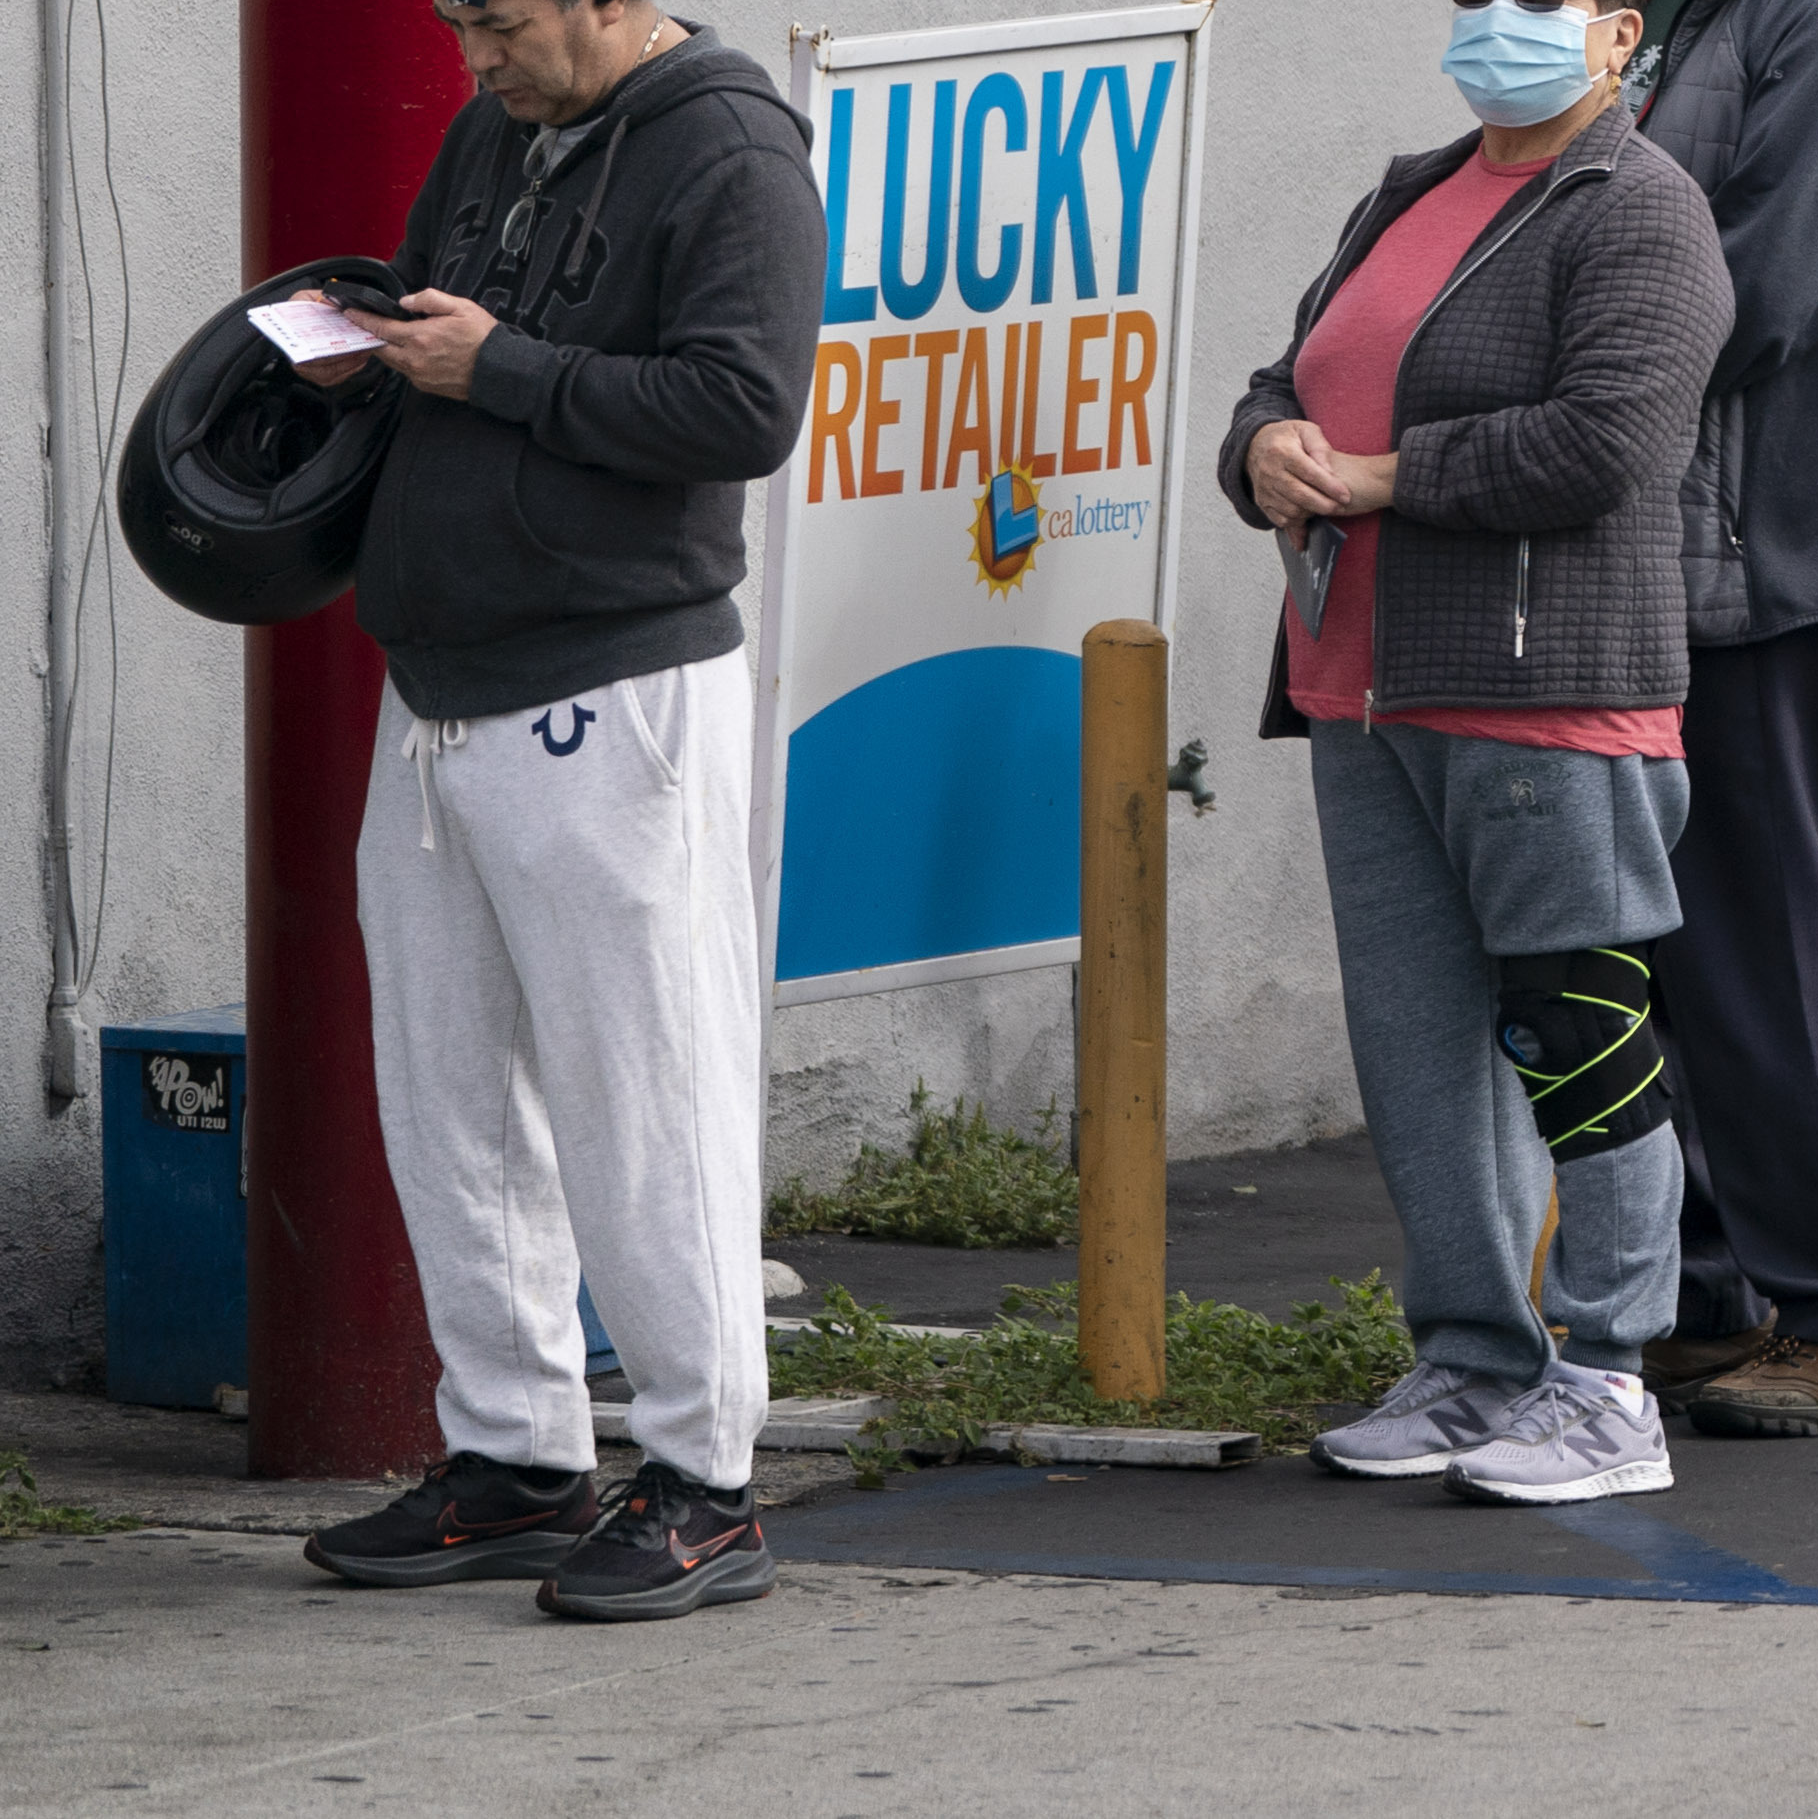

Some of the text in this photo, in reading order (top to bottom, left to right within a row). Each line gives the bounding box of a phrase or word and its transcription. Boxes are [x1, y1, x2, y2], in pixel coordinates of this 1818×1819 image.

[822, 61, 1176, 325] LUCKY
[807, 310, 1157, 504] RETAILER
[1049, 494, 1150, 540] calottery
[148, 1056, 224, 1115] KAPOW!
